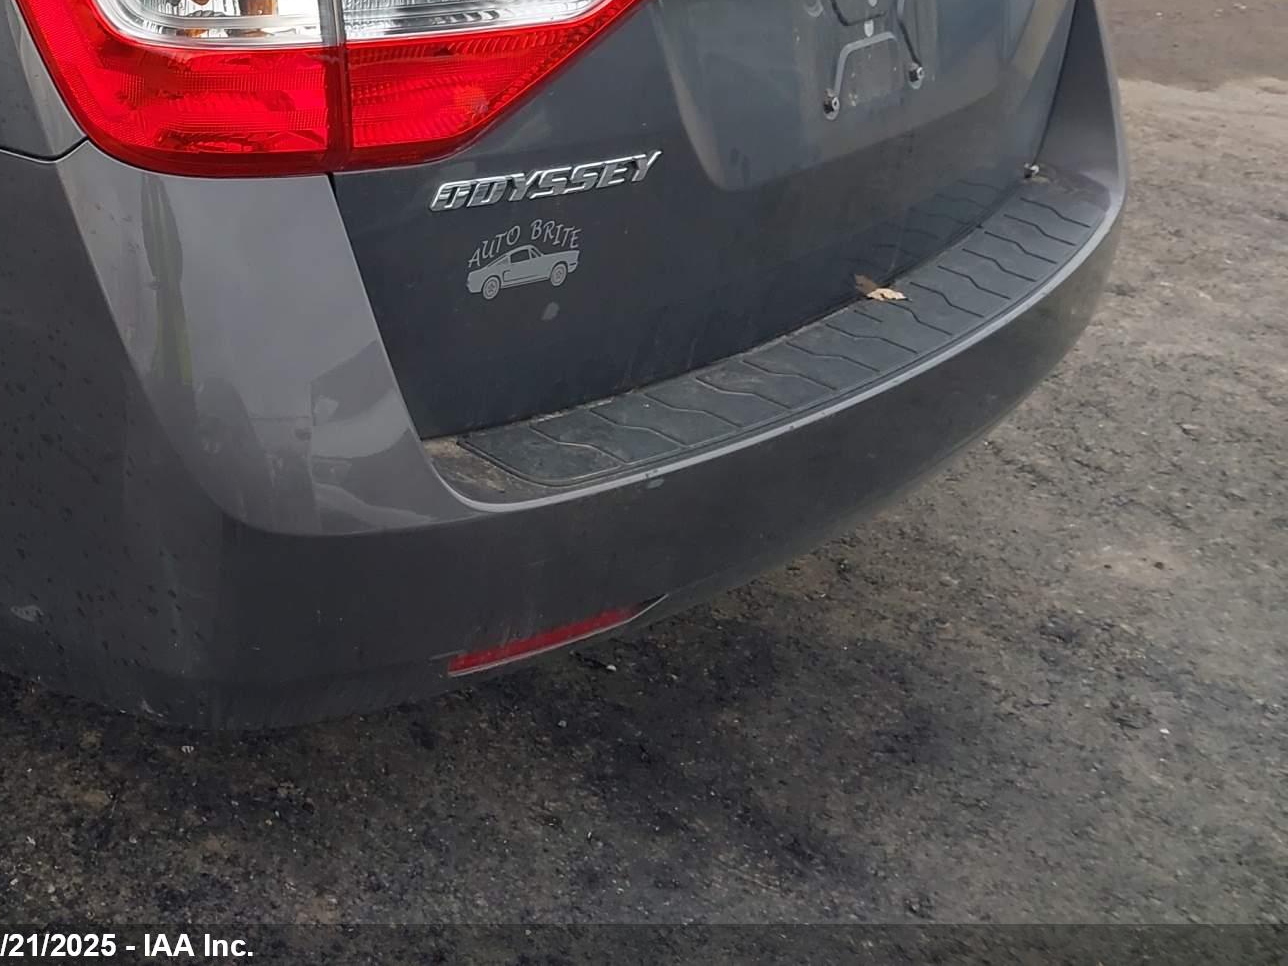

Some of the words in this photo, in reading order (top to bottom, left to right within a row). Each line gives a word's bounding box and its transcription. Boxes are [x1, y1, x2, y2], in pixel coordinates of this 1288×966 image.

[429, 150, 662, 212] ODYSSEY
[468, 225, 521, 268] AUTO
[530, 218, 582, 249] BRITE
